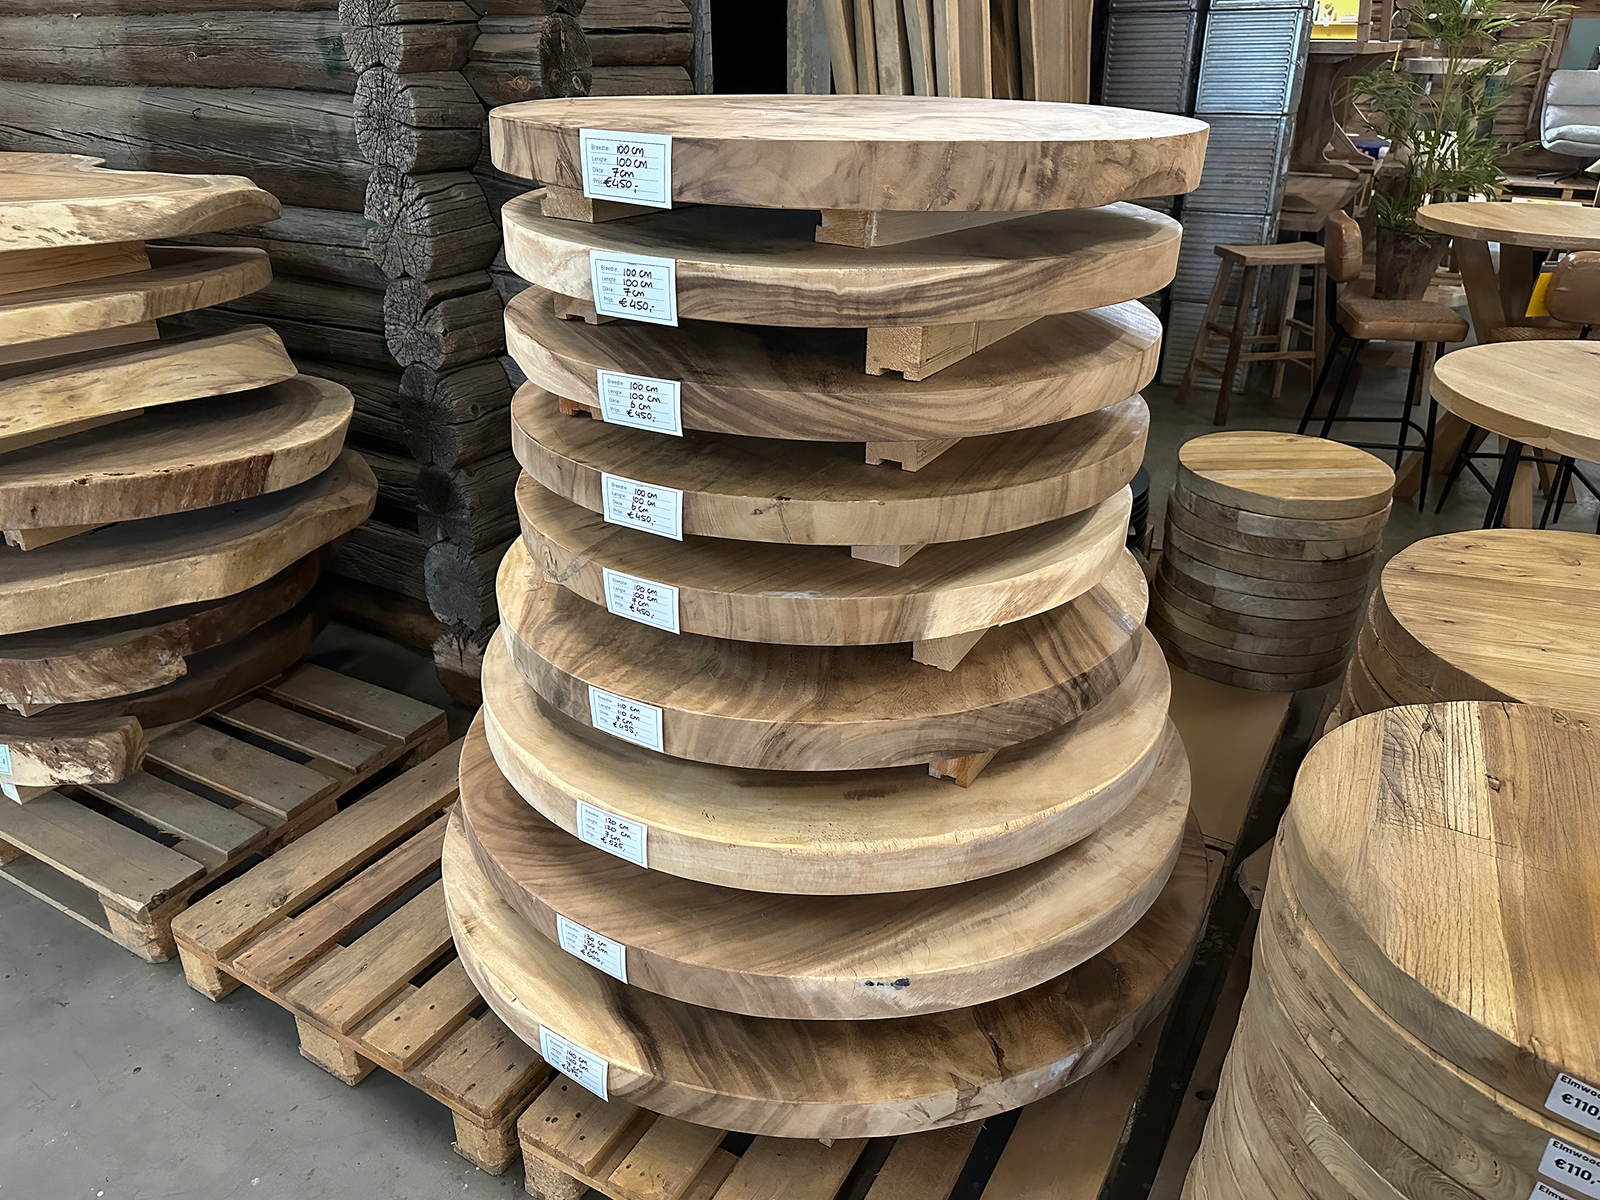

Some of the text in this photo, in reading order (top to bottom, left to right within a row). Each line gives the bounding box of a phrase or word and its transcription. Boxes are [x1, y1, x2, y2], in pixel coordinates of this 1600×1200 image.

[617, 145, 629, 154] 100
[631, 147, 644, 157] cm
[616, 157, 631, 167] 100
[634, 159, 647, 169] cm
[612, 168, 619, 177] 7
[623, 269, 636, 277] 100
[639, 270, 652, 278] cm
[623, 279, 638, 287] 100
[623, 288, 631, 296] 7
[630, 382, 643, 390] 100
[647, 395, 661, 403] cm
[635, 488, 645, 497] 100
[633, 496, 644, 504] 100
[631, 502, 636, 510] 6
[634, 584, 645, 593] 100
[647, 588, 657, 596] cm
[619, 823, 629, 831] cm
[621, 831, 631, 839] cm
[589, 948, 599, 956] cm
[597, 946, 608, 955] cm
[567, 1050, 577, 1059] 140
[578, 1057, 588, 1065] cm
[566, 1056, 577, 1065] 140
[579, 1064, 589, 1072] cm
